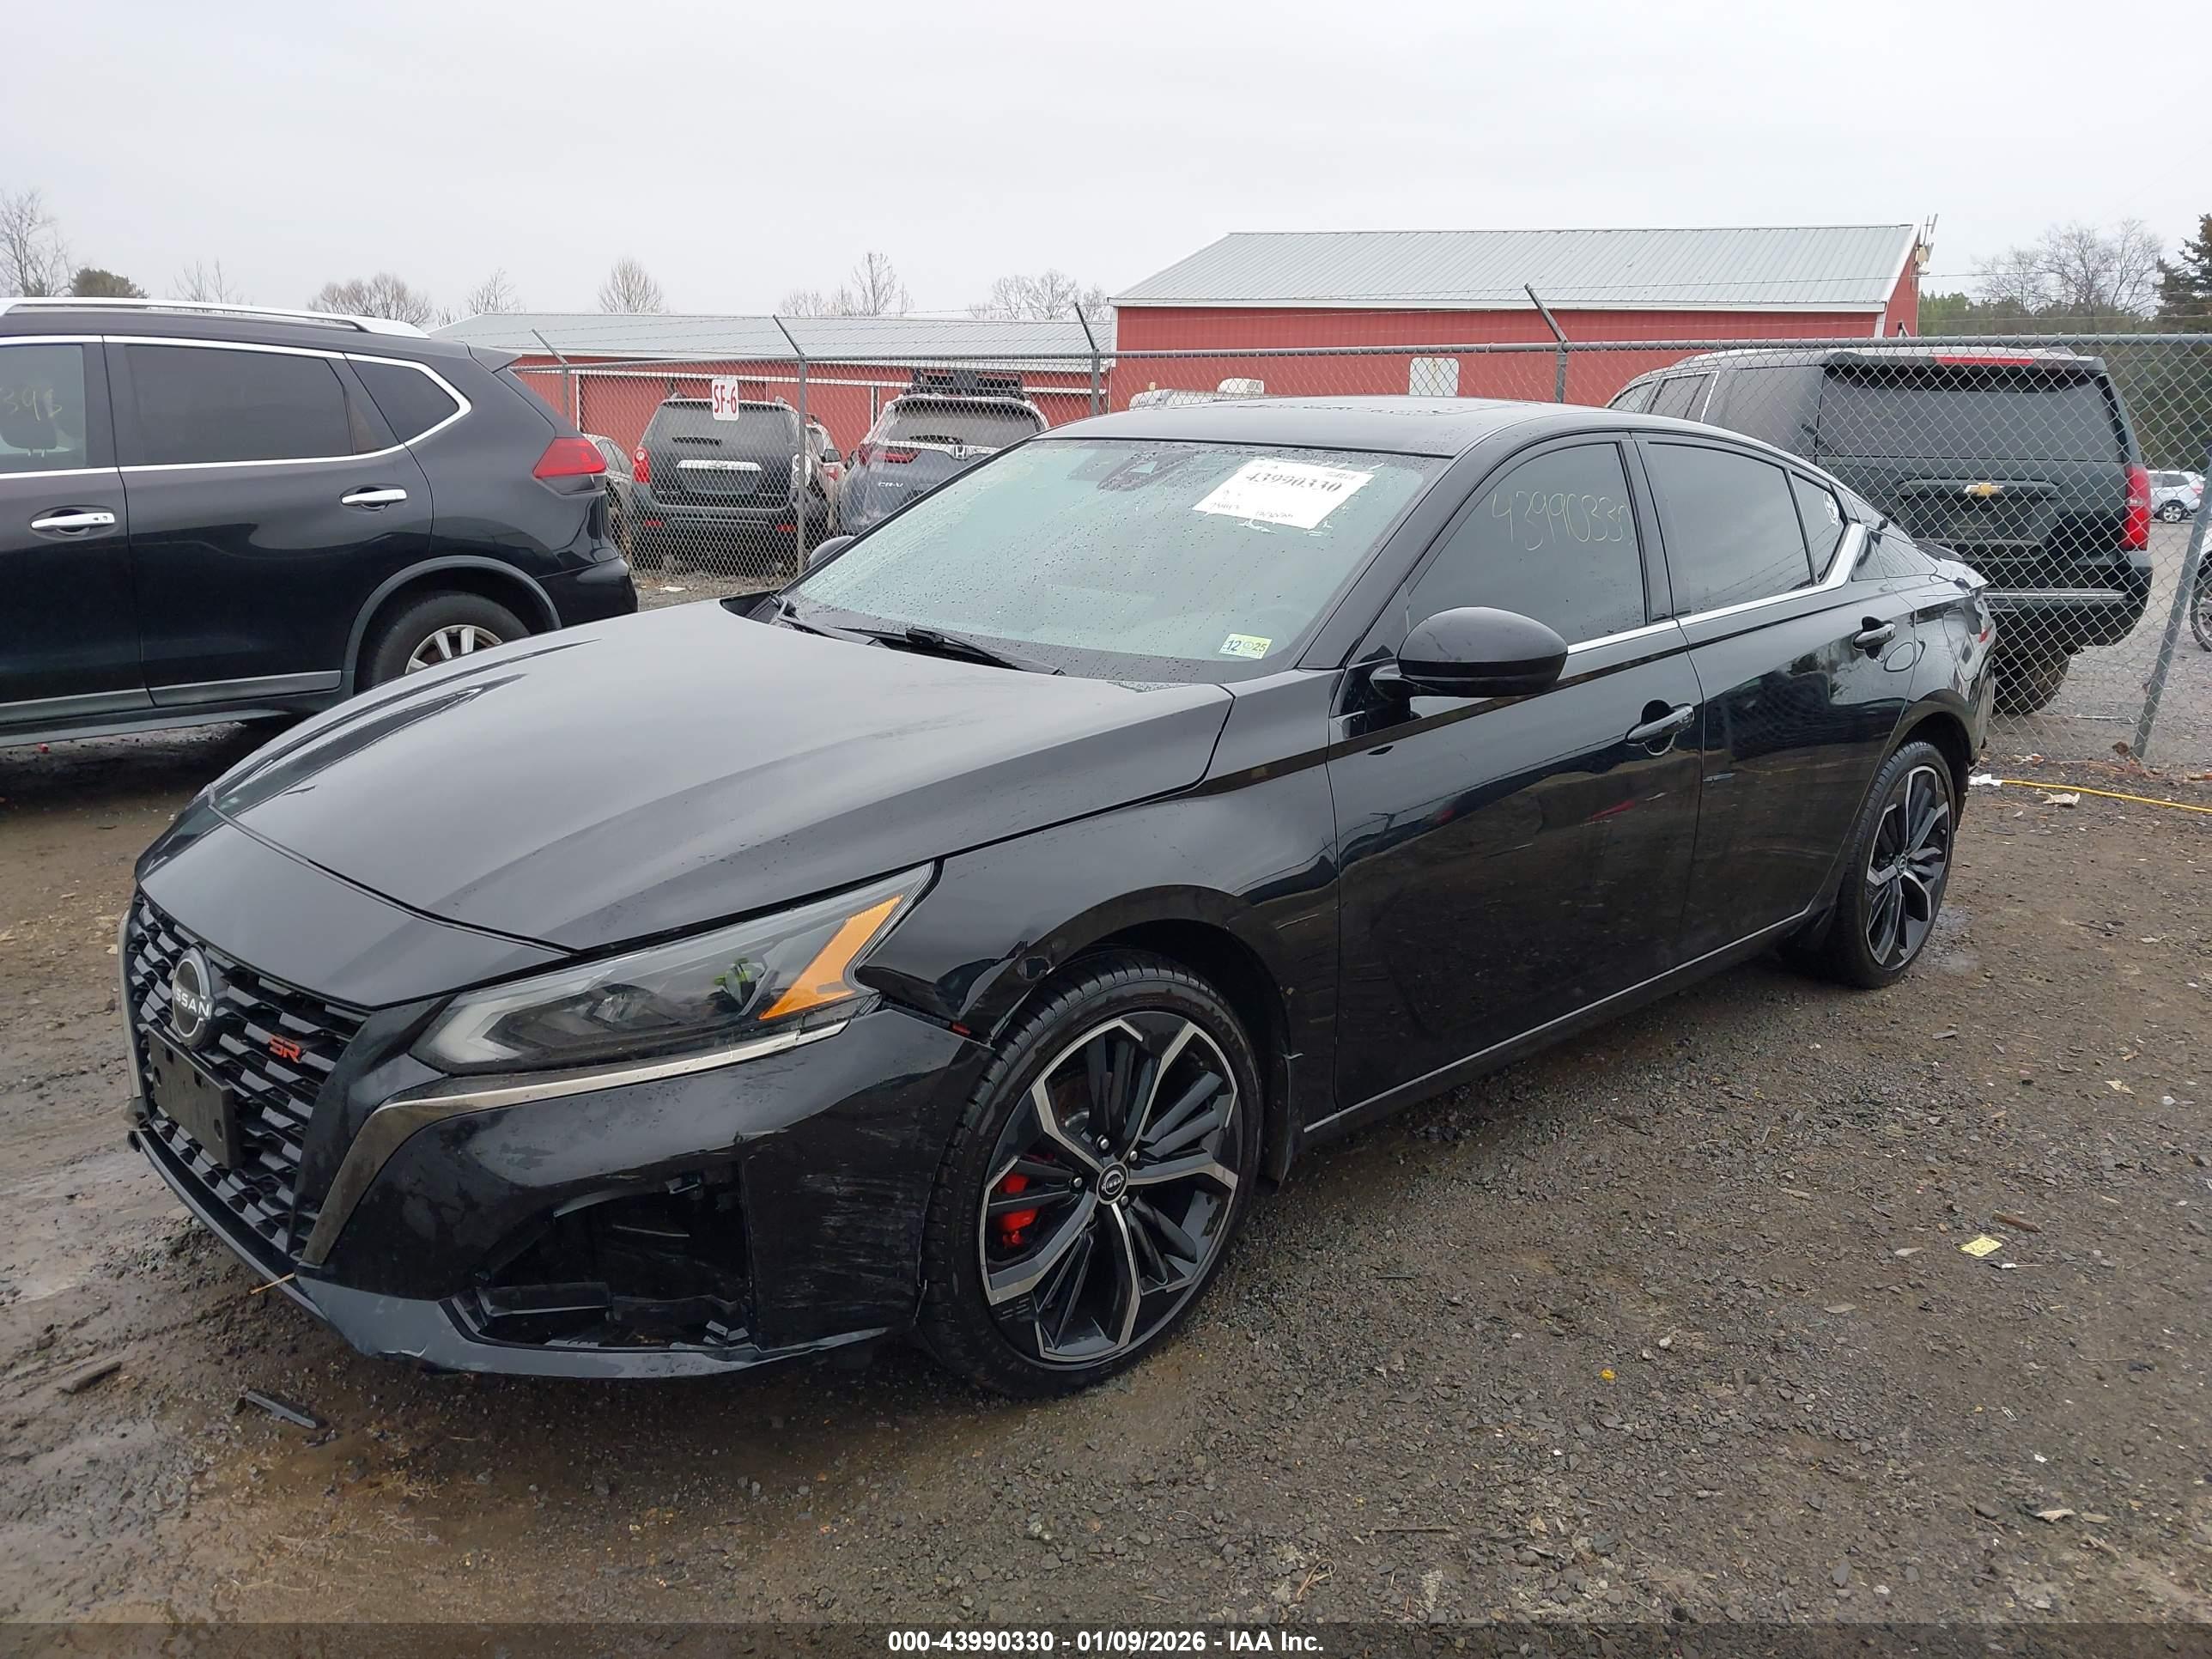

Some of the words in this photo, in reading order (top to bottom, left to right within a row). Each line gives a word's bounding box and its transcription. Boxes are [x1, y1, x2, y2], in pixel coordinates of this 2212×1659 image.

[714, 385, 737, 414] SF-6
[1245, 471, 1343, 493] 43990330
[1226, 640, 1242, 652] 12
[1252, 642, 1267, 652] 25
[269, 1035, 301, 1064] SR
